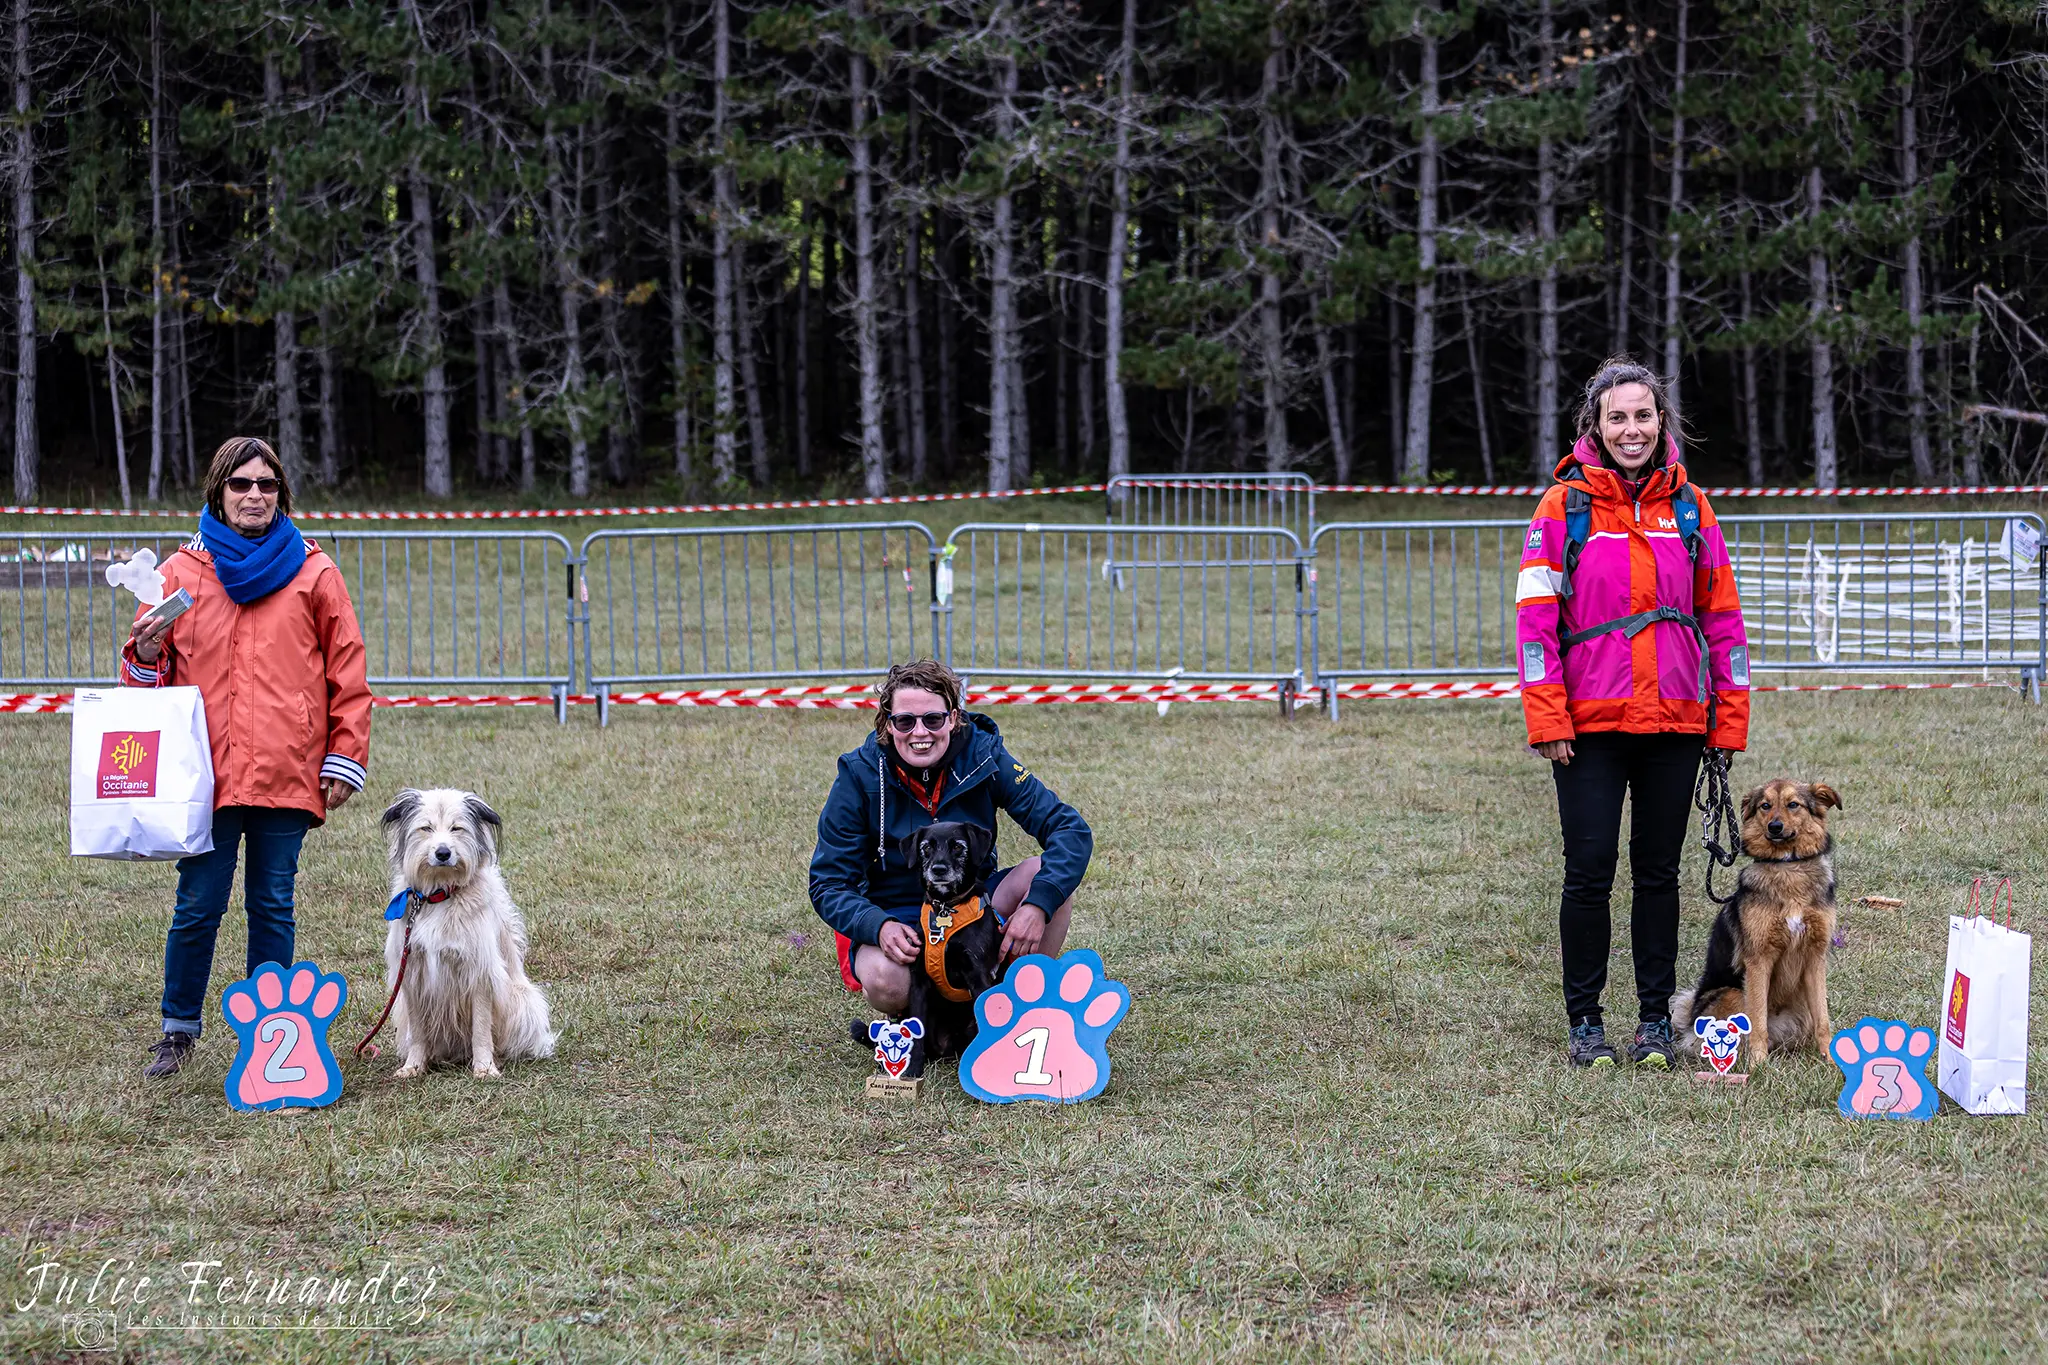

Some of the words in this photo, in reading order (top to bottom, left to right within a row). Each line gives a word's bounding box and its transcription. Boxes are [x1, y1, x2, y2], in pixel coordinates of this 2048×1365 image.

[103, 780, 148, 790] Occitanie
[261, 1017, 307, 1083] 2
[1014, 1027, 1053, 1085] 1
[1871, 1064, 1903, 1110] 3
